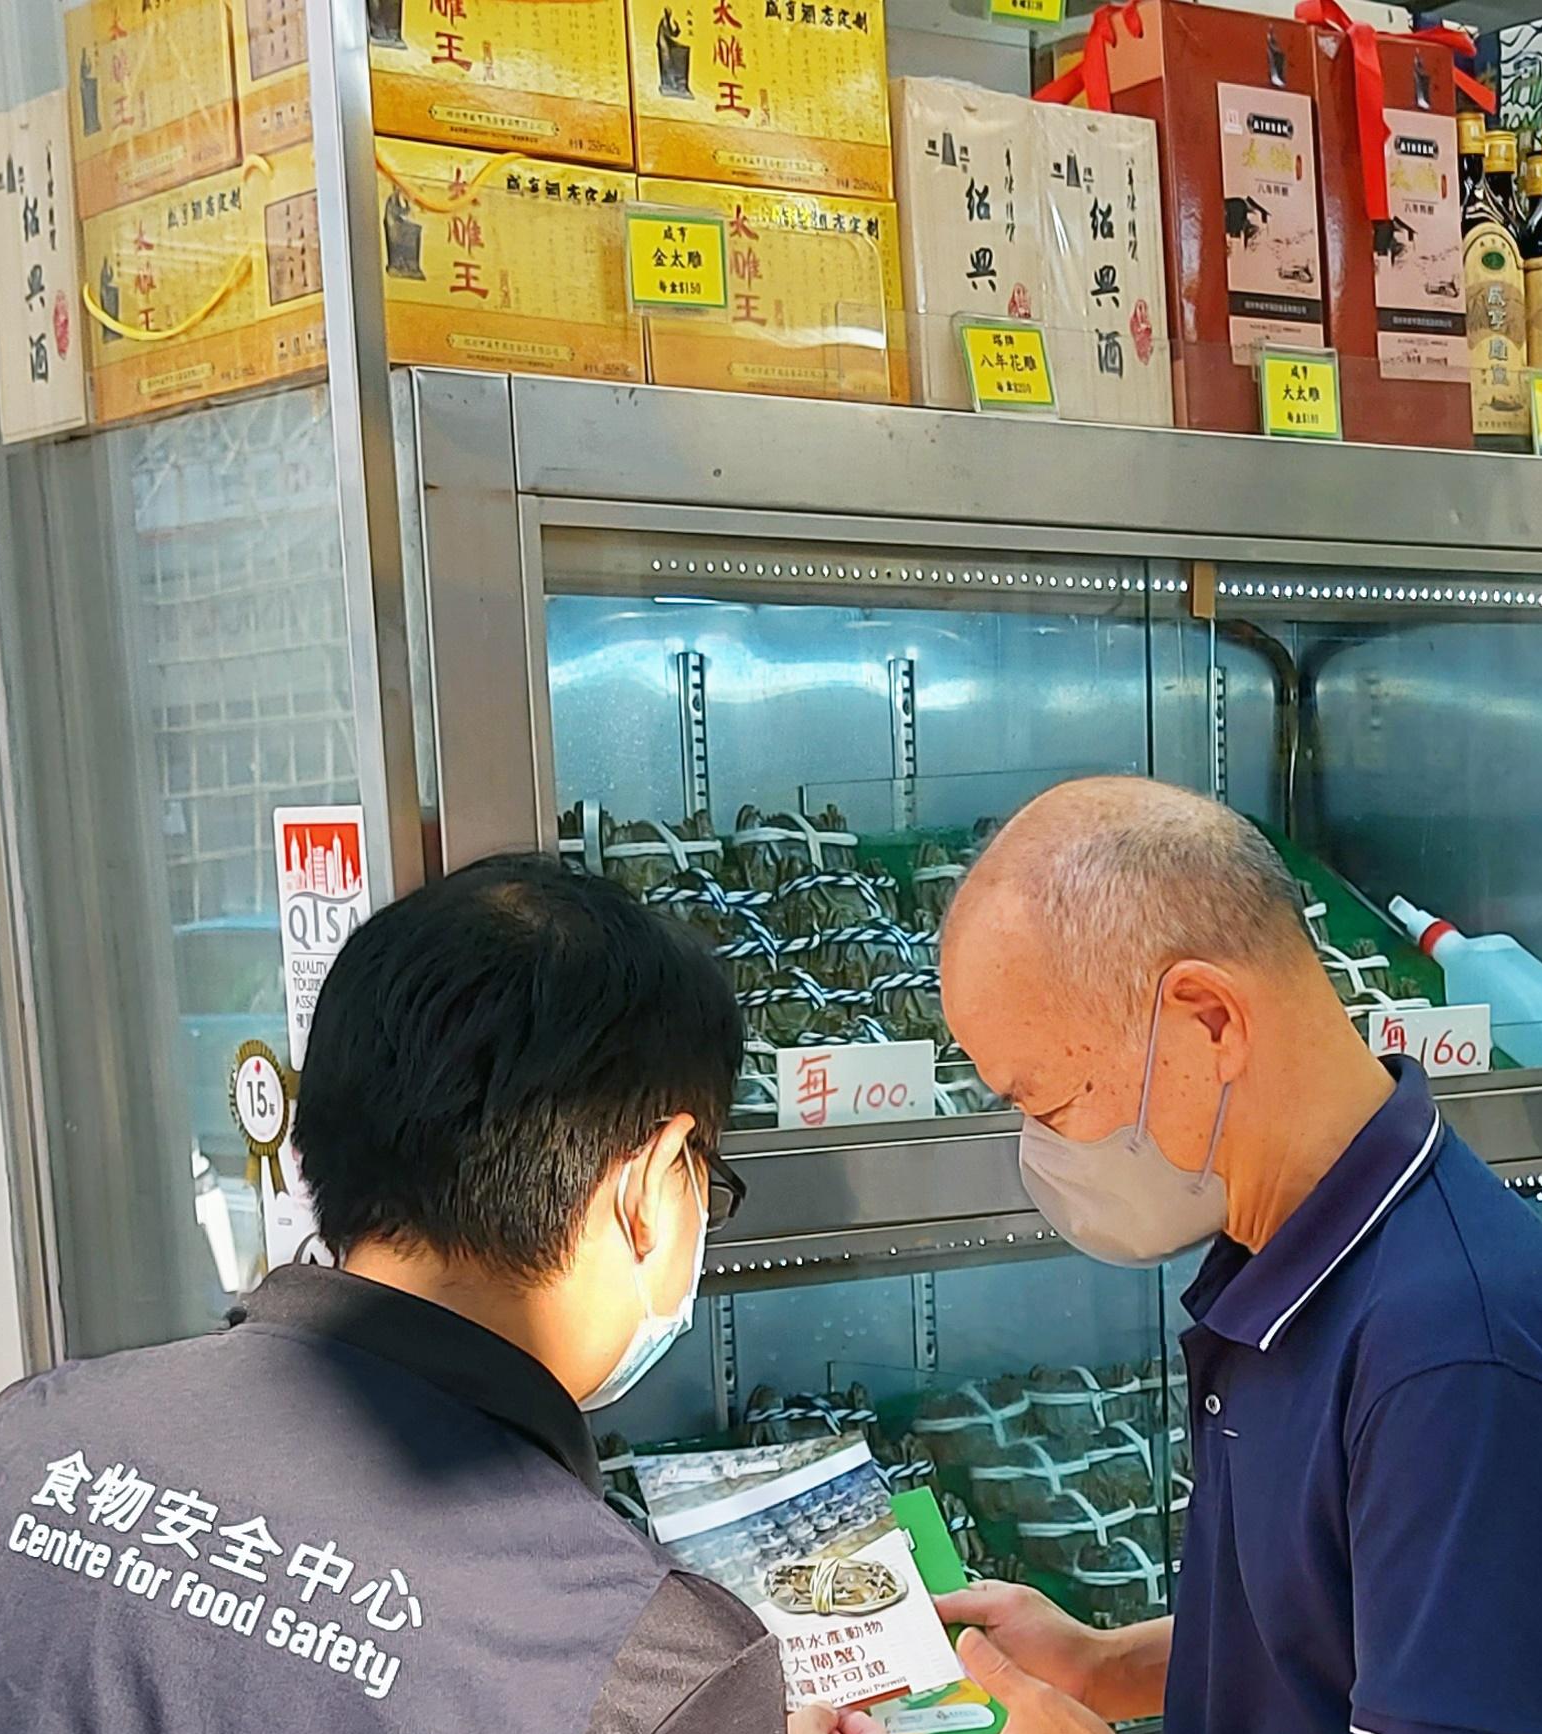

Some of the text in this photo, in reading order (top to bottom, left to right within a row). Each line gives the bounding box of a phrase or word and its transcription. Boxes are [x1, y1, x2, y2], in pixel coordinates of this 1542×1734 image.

[652, 248, 703, 269] 金太雕
[30, 1449, 424, 1632] 食物安全中心
[8, 1512, 403, 1700] Centre for Food Safety
[780, 1620, 884, 1654] 類水產動物
